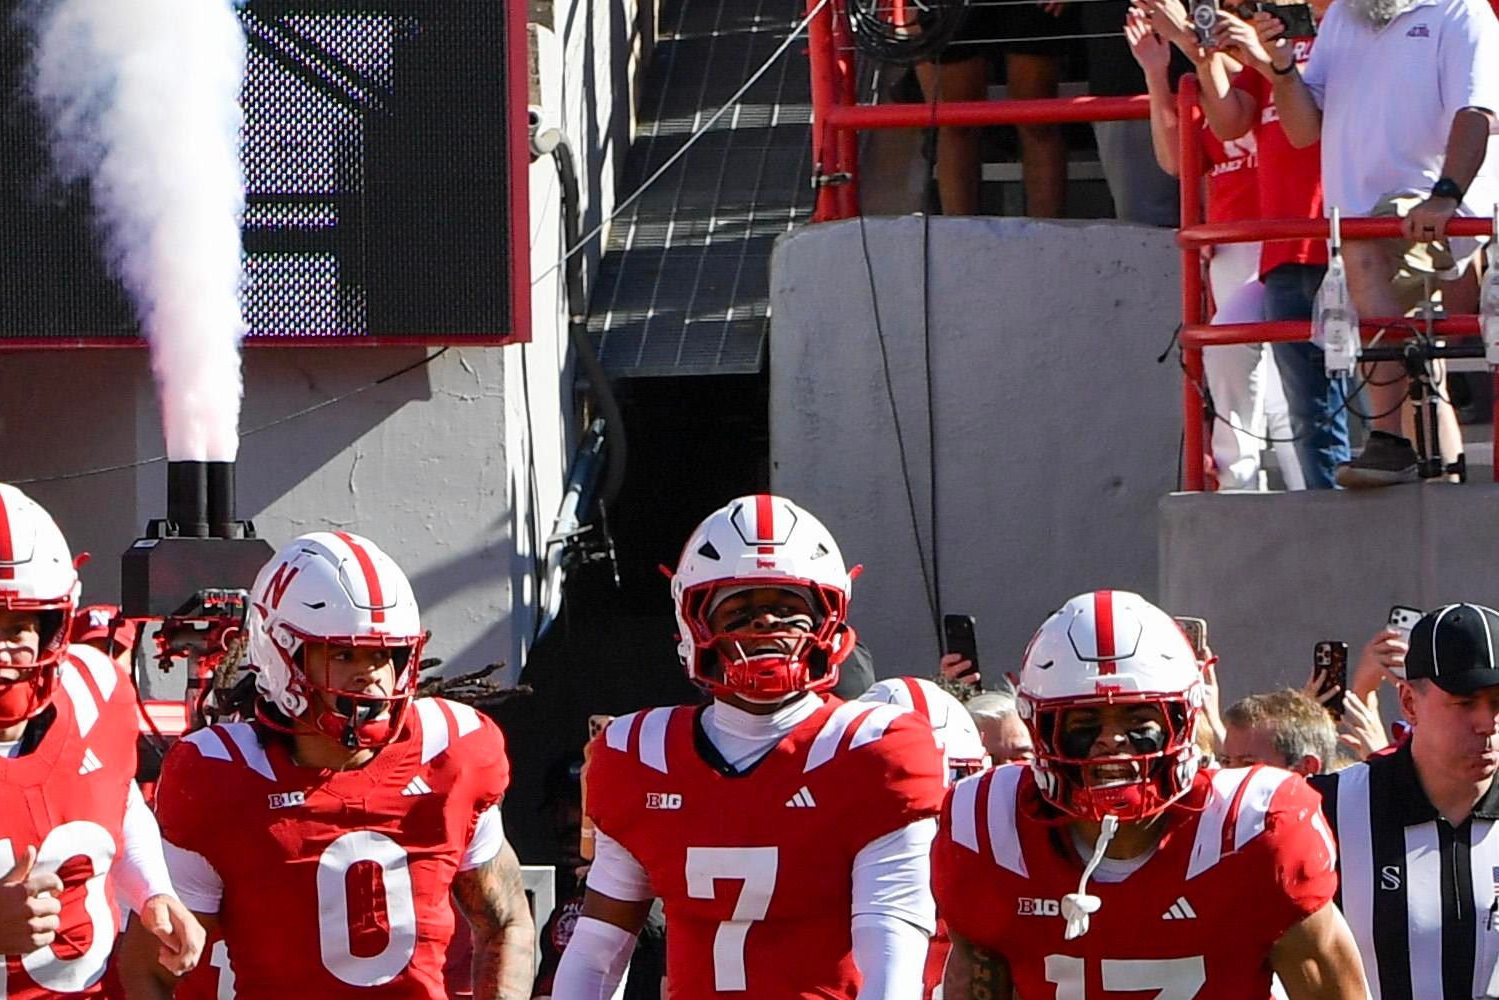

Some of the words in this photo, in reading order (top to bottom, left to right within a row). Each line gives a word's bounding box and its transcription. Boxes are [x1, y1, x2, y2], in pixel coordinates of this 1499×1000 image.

[263, 561, 299, 611] N
[316, 830, 417, 988] 0
[685, 846, 779, 992] 7
[1380, 865, 1402, 891] S
